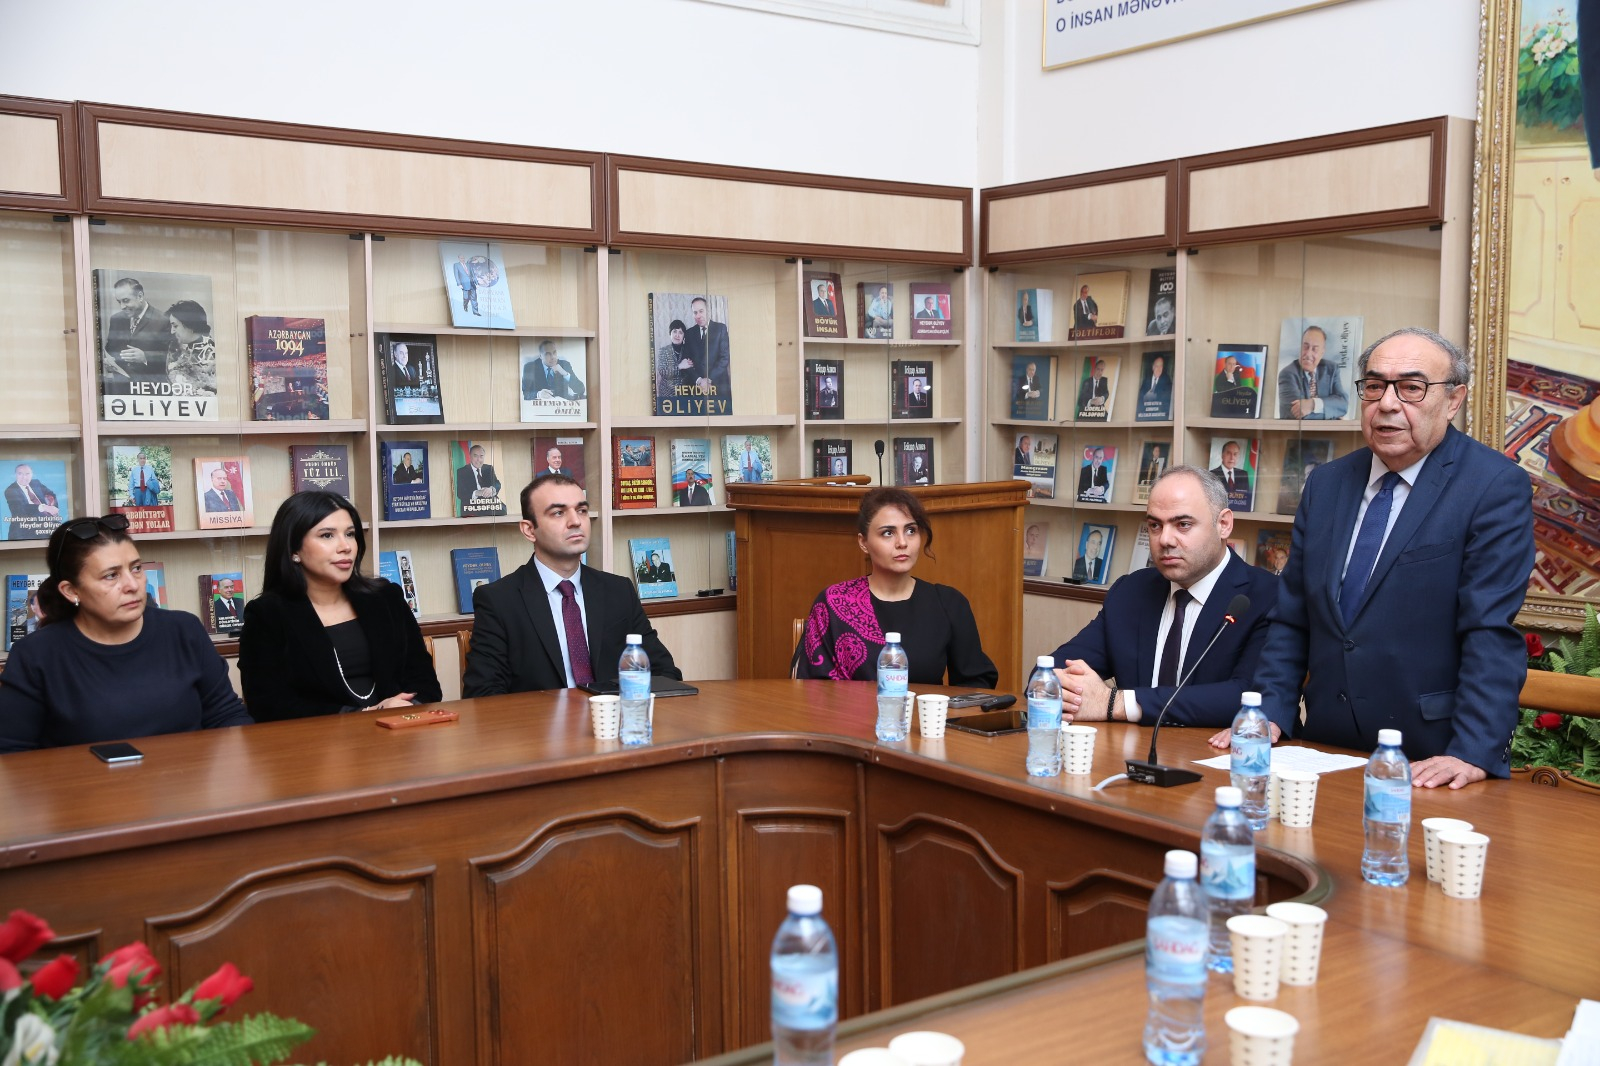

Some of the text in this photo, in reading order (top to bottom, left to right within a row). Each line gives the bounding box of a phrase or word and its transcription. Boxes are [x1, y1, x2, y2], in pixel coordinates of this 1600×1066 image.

[1056, 17, 1066, 32] O
[1070, 5, 1113, 29] İNSAN
[268, 329, 311, 340] AZƏRBAYCAN
[275, 339, 304, 356] 1994
[129, 381, 194, 395] HEYDƏR
[674, 385, 717, 396] HEYDƏR
[303, 467, 320, 477] YÜZ
